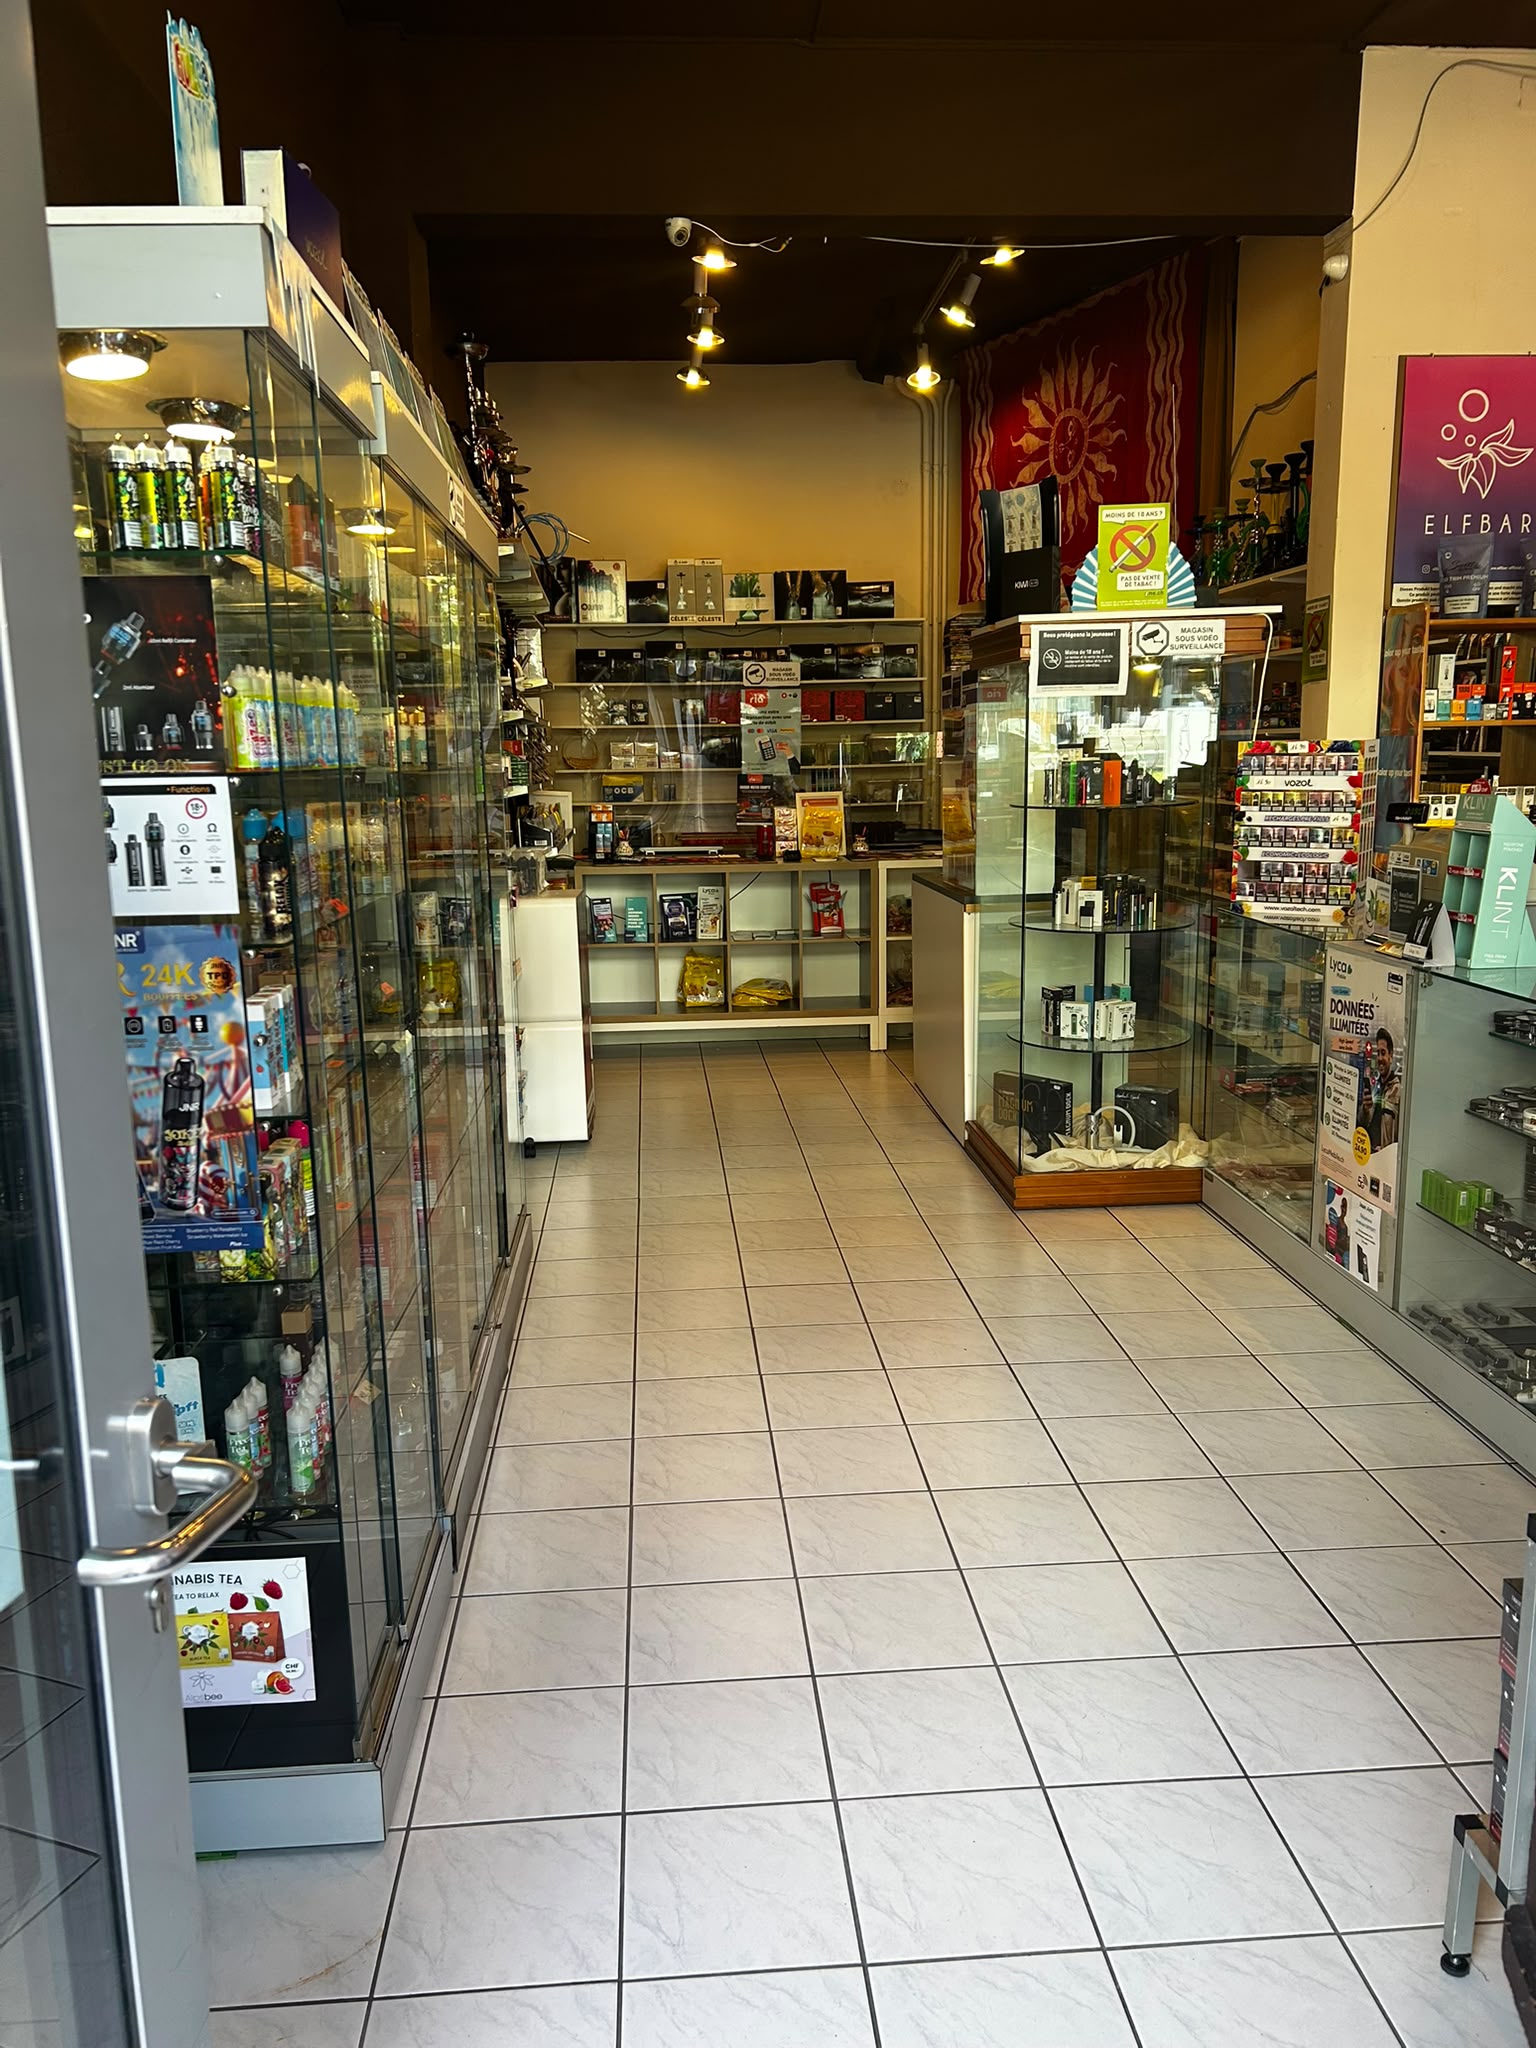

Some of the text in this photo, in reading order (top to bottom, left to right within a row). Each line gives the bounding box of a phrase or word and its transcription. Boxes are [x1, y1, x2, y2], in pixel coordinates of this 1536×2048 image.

[1425, 513, 1532, 534] ELFBAR
[1015, 580, 1028, 589] KIWI
[99, 760, 126, 774] ST
[131, 759, 158, 774] GO
[1491, 867, 1518, 939] KLINT
[114, 934, 138, 947] NR
[1329, 956, 1347, 973] Lyca
[140, 962, 196, 987] 24K
[1330, 998, 1375, 1020] DONNÉES
[1329, 1017, 1370, 1036] ILLIMITÉES
[172, 1573, 243, 1586] NABIS TEA
